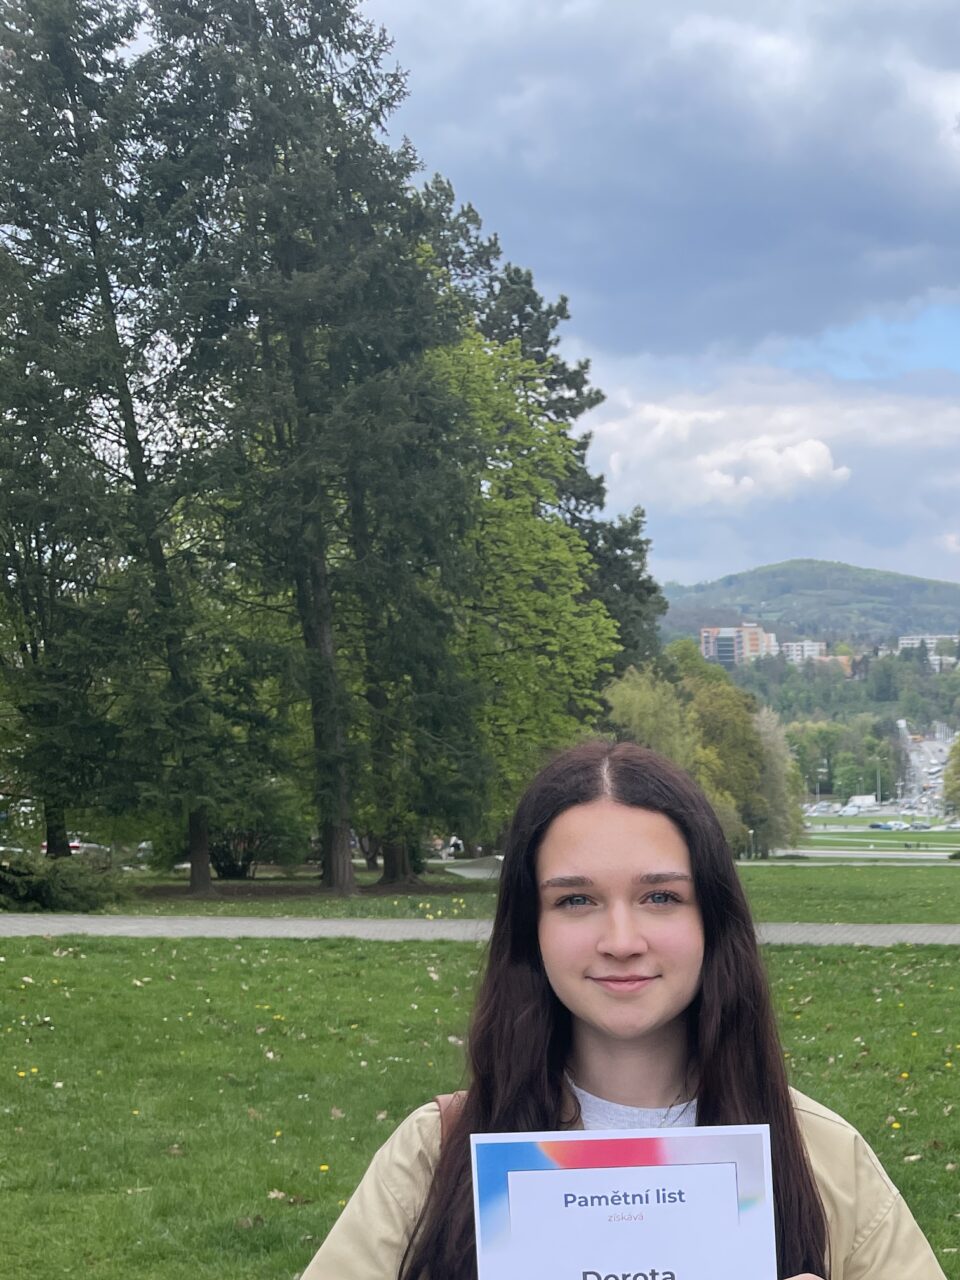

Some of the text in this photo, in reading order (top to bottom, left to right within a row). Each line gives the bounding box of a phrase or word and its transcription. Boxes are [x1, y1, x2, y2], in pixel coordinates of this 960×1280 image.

[564, 1188, 686, 1208] Pamětní list
[608, 1212, 644, 1222] získává
